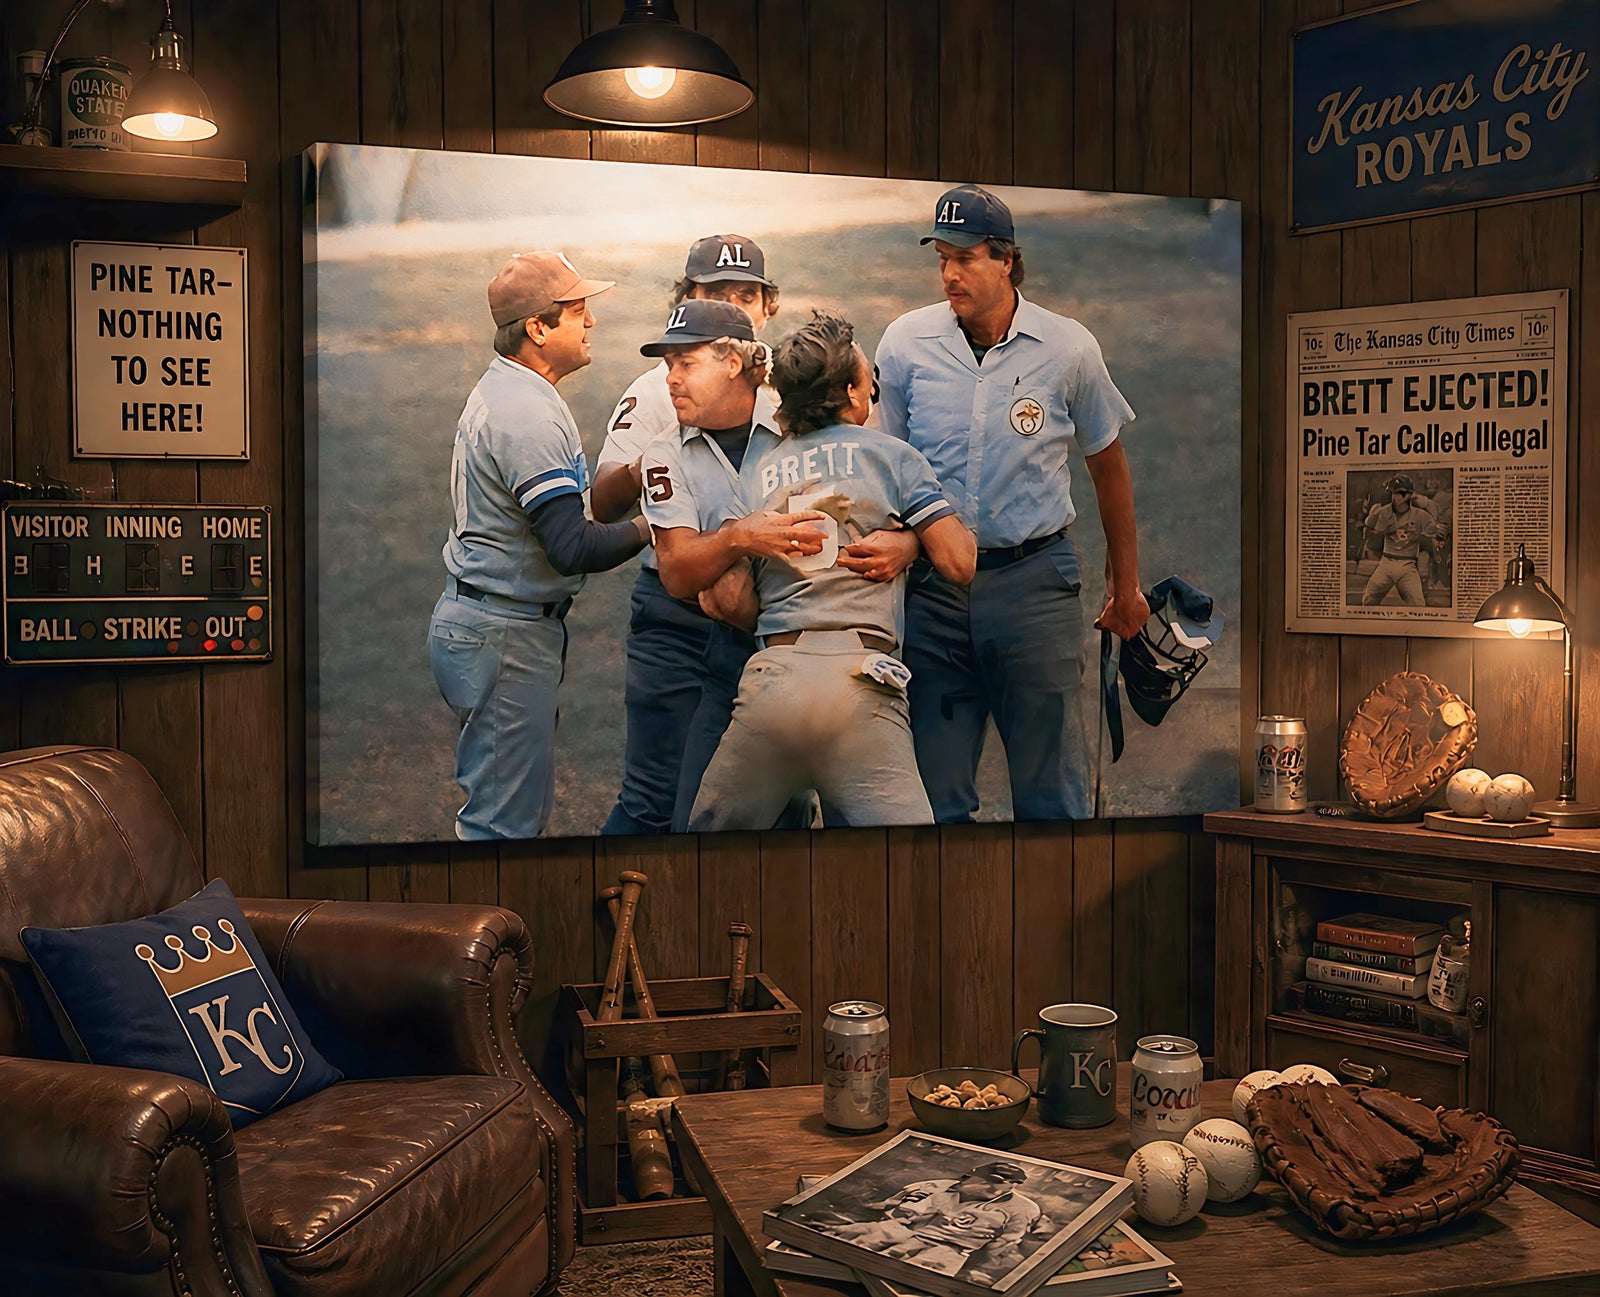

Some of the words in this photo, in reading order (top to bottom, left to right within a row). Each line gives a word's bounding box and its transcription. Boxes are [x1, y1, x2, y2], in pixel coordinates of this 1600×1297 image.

[76, 96, 126, 119] STATE
[1307, 74, 1480, 154] Kansas
[1493, 42, 1589, 121] City
[1355, 112, 1532, 188] ROYALS
[937, 201, 965, 224] AL
[716, 244, 750, 268] AL
[91, 263, 153, 293] PINE
[98, 308, 222, 341] NOTHING
[1334, 331, 1362, 355] The
[1366, 329, 1423, 349] Kansas
[1427, 324, 1460, 349] City
[1465, 322, 1515, 343] Times
[111, 355, 147, 386] TO
[161, 356, 211, 387] SEE
[1303, 377, 1394, 417] BRETT
[1403, 368, 1549, 413] EJECTED!
[121, 402, 203, 433] HERE!
[612, 397, 637, 432] 2
[1303, 428, 1350, 457] Pine
[1355, 426, 1391, 456] Tar
[1397, 422, 1469, 455] Called
[1476, 420, 1549, 458] Illegal
[646, 466, 673, 502] 5
[760, 441, 861, 499] BRETT
[11, 515, 89, 538] VISITOR
[106, 516, 182, 538] INNING
[203, 517, 262, 539] HOME
[87, 555, 101, 575] H
[181, 555, 194, 575] E
[250, 555, 262, 576] E
[20, 619, 77, 642] BALL
[103, 617, 183, 641] STRIKE
[205, 616, 247, 638] OUT
[188, 995, 294, 1076] KC
[1068, 1051, 1112, 1097] KC
